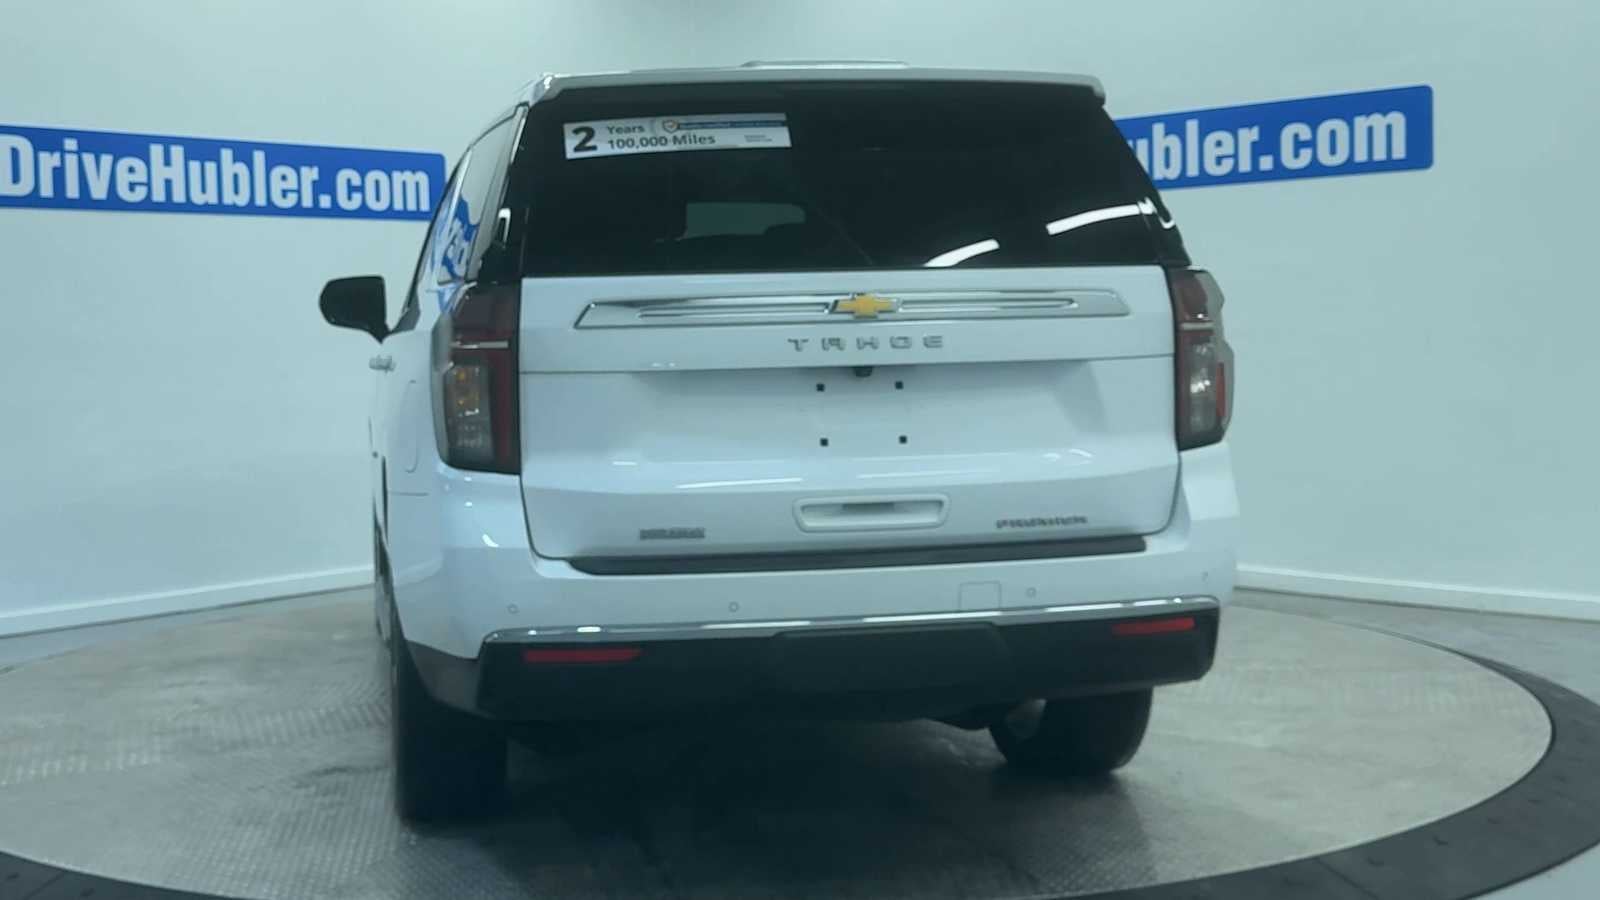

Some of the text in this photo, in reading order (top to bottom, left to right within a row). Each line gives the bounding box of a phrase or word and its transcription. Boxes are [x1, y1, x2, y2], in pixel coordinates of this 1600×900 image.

[572, 126, 598, 152] 2
[606, 123, 645, 135] Years
[607, 131, 716, 151] 100,000 Miles
[0, 134, 430, 212] DriveHubler.com
[787, 335, 944, 352] TAHOE
